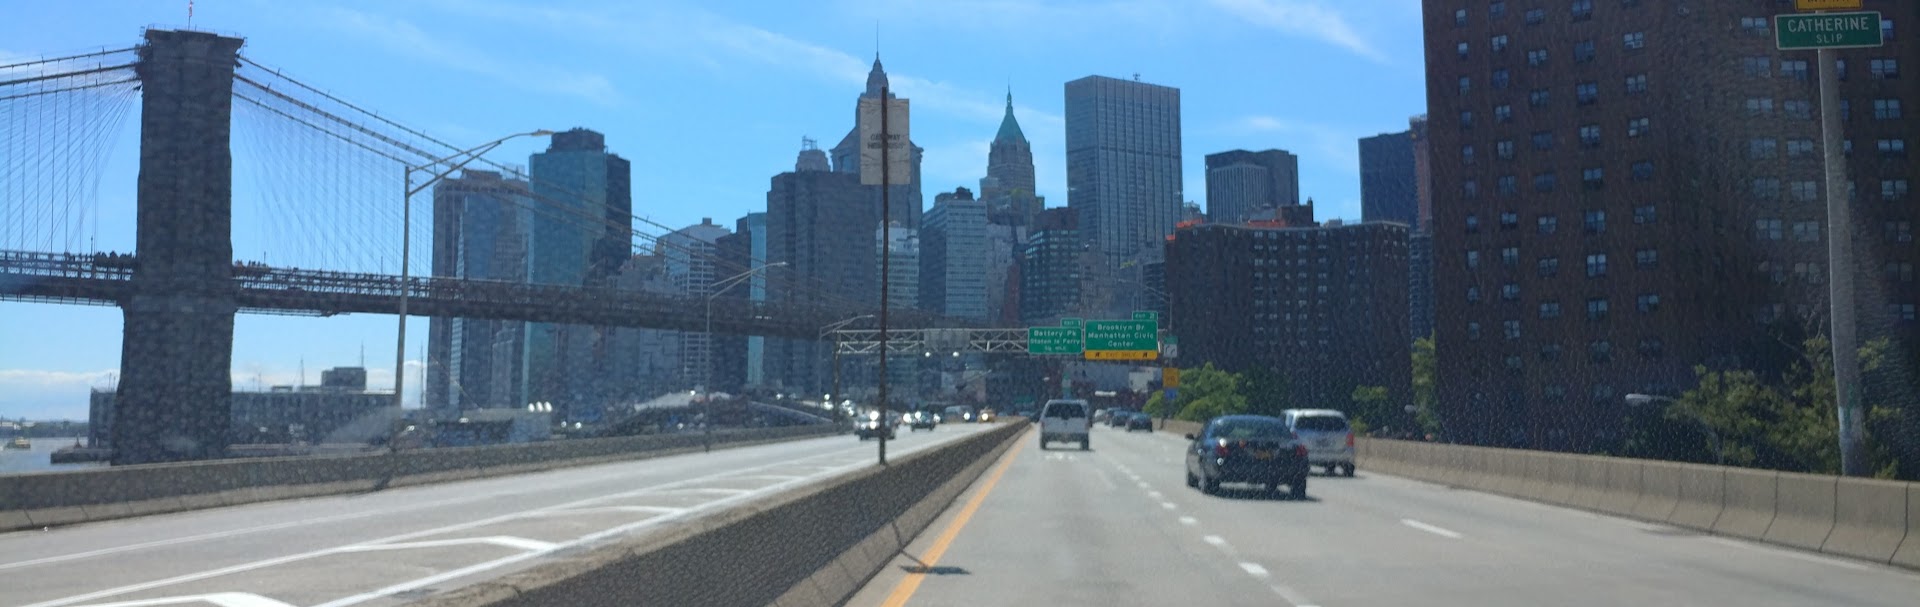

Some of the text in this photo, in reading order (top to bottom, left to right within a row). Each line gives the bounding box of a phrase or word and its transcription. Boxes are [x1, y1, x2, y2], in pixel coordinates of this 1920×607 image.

[1787, 17, 1869, 33] CATHERINE
[1816, 34, 1843, 44] SLIP
[1097, 323, 1133, 332] Brooklyn
[1033, 330, 1063, 338] Battery
[1062, 338, 1081, 346] Ferry
